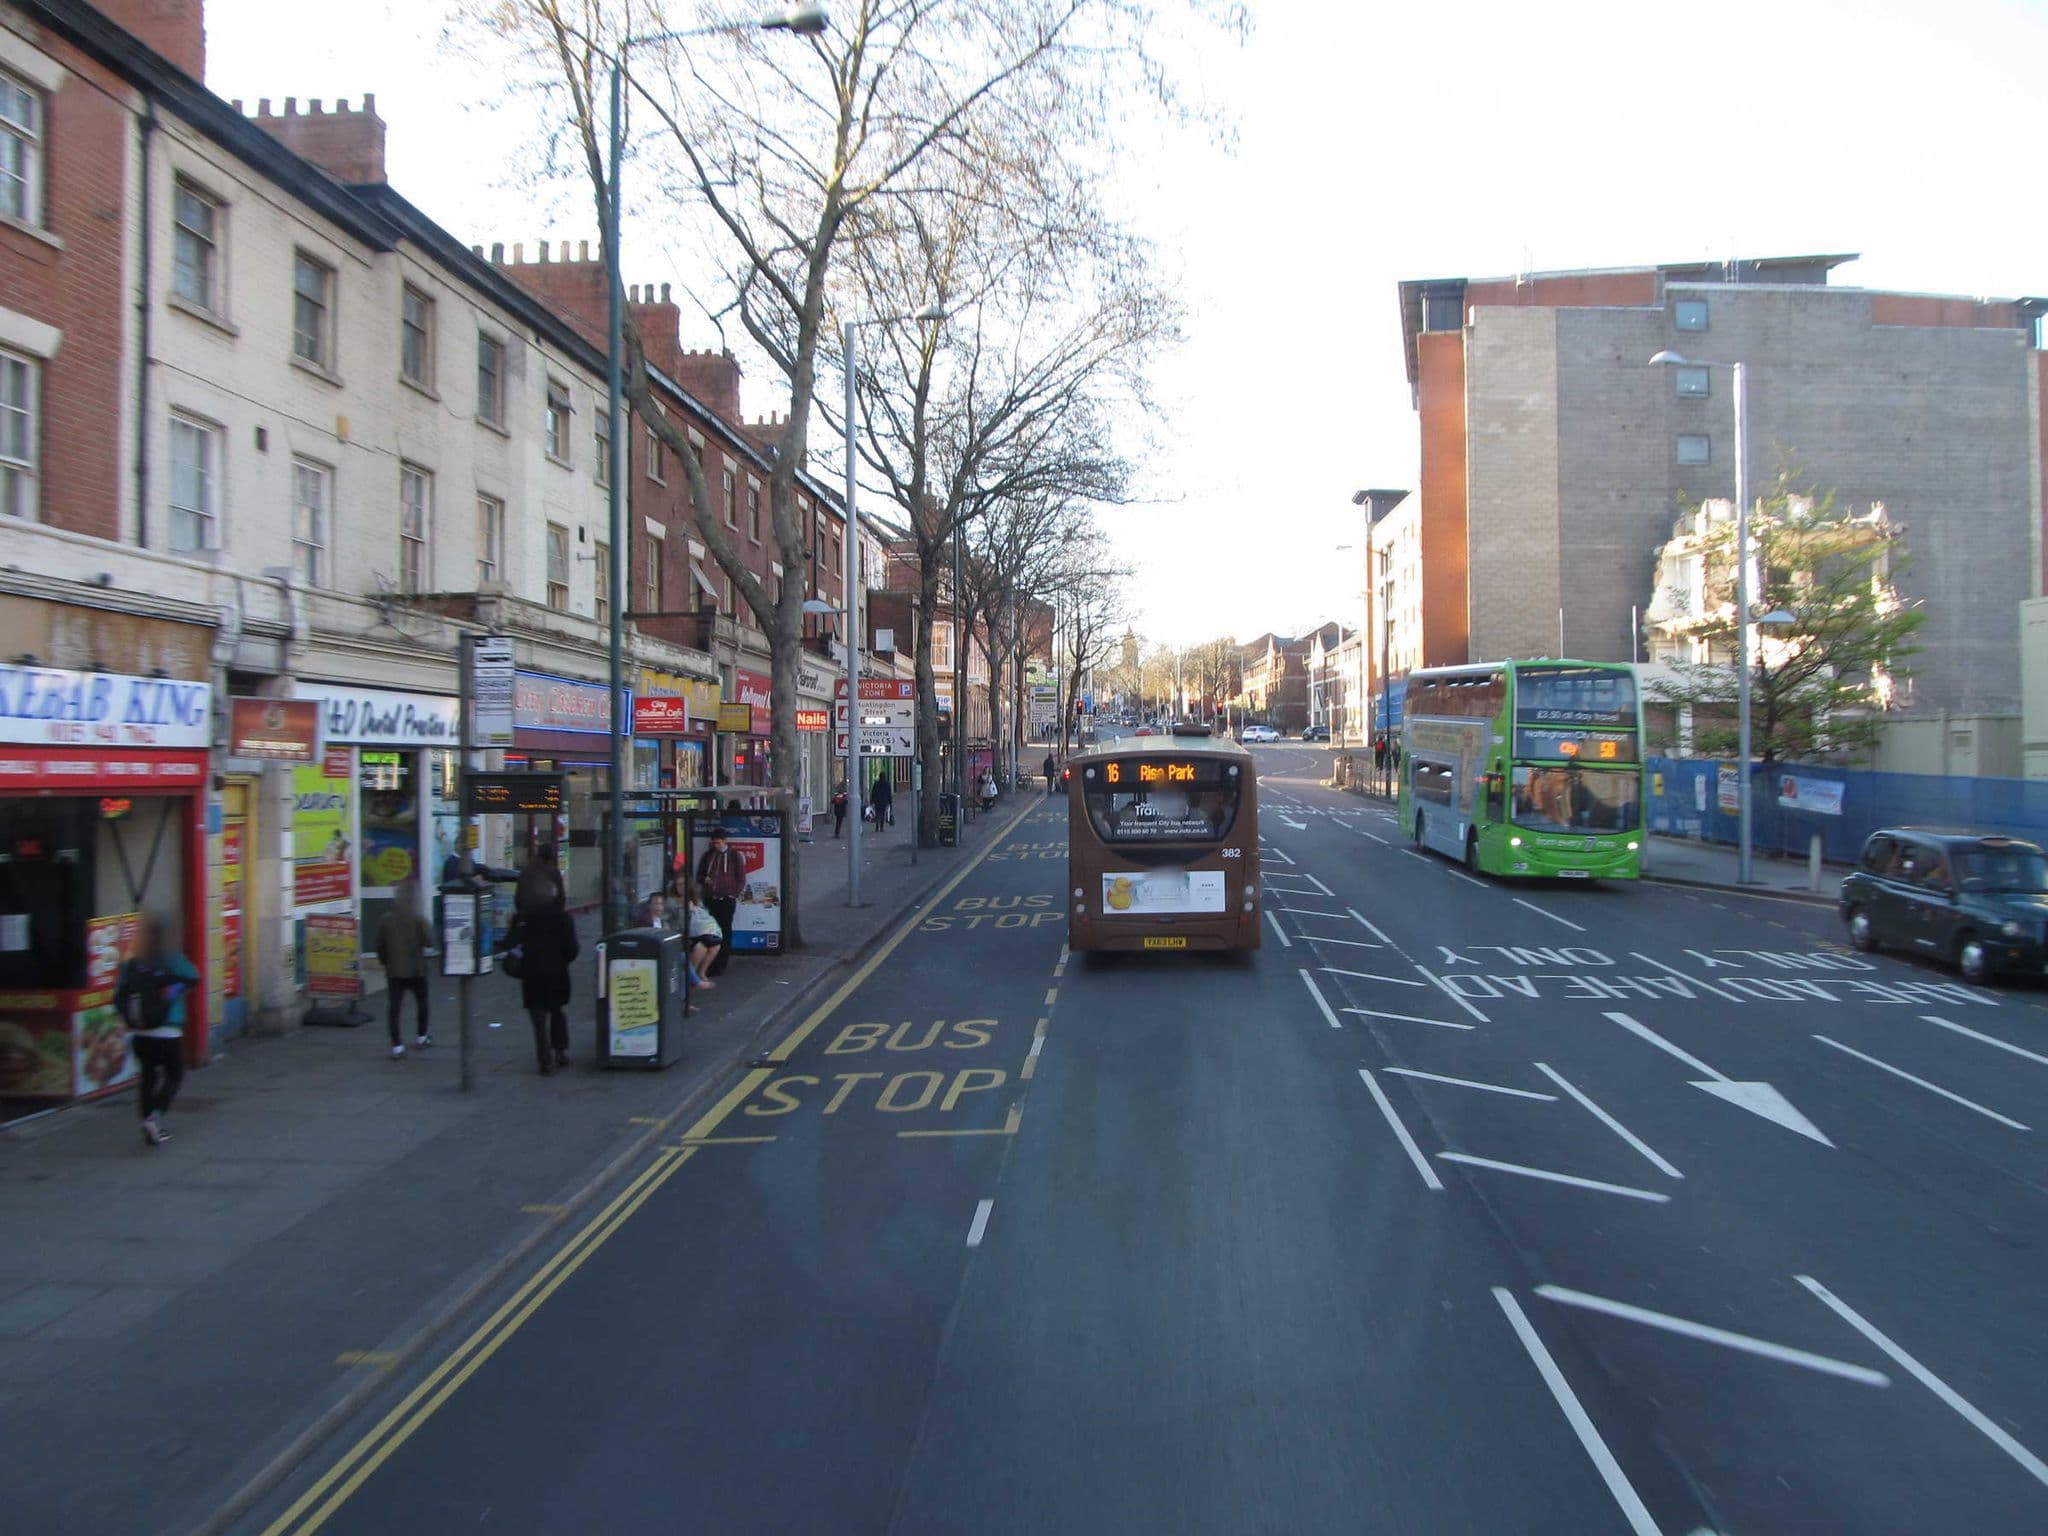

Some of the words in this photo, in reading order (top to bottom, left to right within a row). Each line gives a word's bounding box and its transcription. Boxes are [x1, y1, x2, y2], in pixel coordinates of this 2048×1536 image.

[902, 684, 911, 695] P
[120, 681, 206, 726] KING
[798, 712, 828, 725] Nails
[1575, 711, 1592, 721] day
[1524, 730, 1574, 740] Nottingham
[1107, 763, 1120, 783] 16
[1140, 764, 1165, 782] Rise
[1168, 763, 1195, 780] Park
[986, 850, 1069, 862] STO
[1222, 848, 1241, 858] 382
[953, 894, 1054, 911] BUS
[919, 911, 1065, 932] STOP
[1436, 945, 1617, 966] ONLY
[1683, 948, 1880, 971] ONLY
[1439, 973, 1699, 1000] AHEAD
[1717, 976, 2002, 1006] AHEAD
[823, 1019, 999, 1055] BUS
[744, 1067, 1007, 1116] STOP
